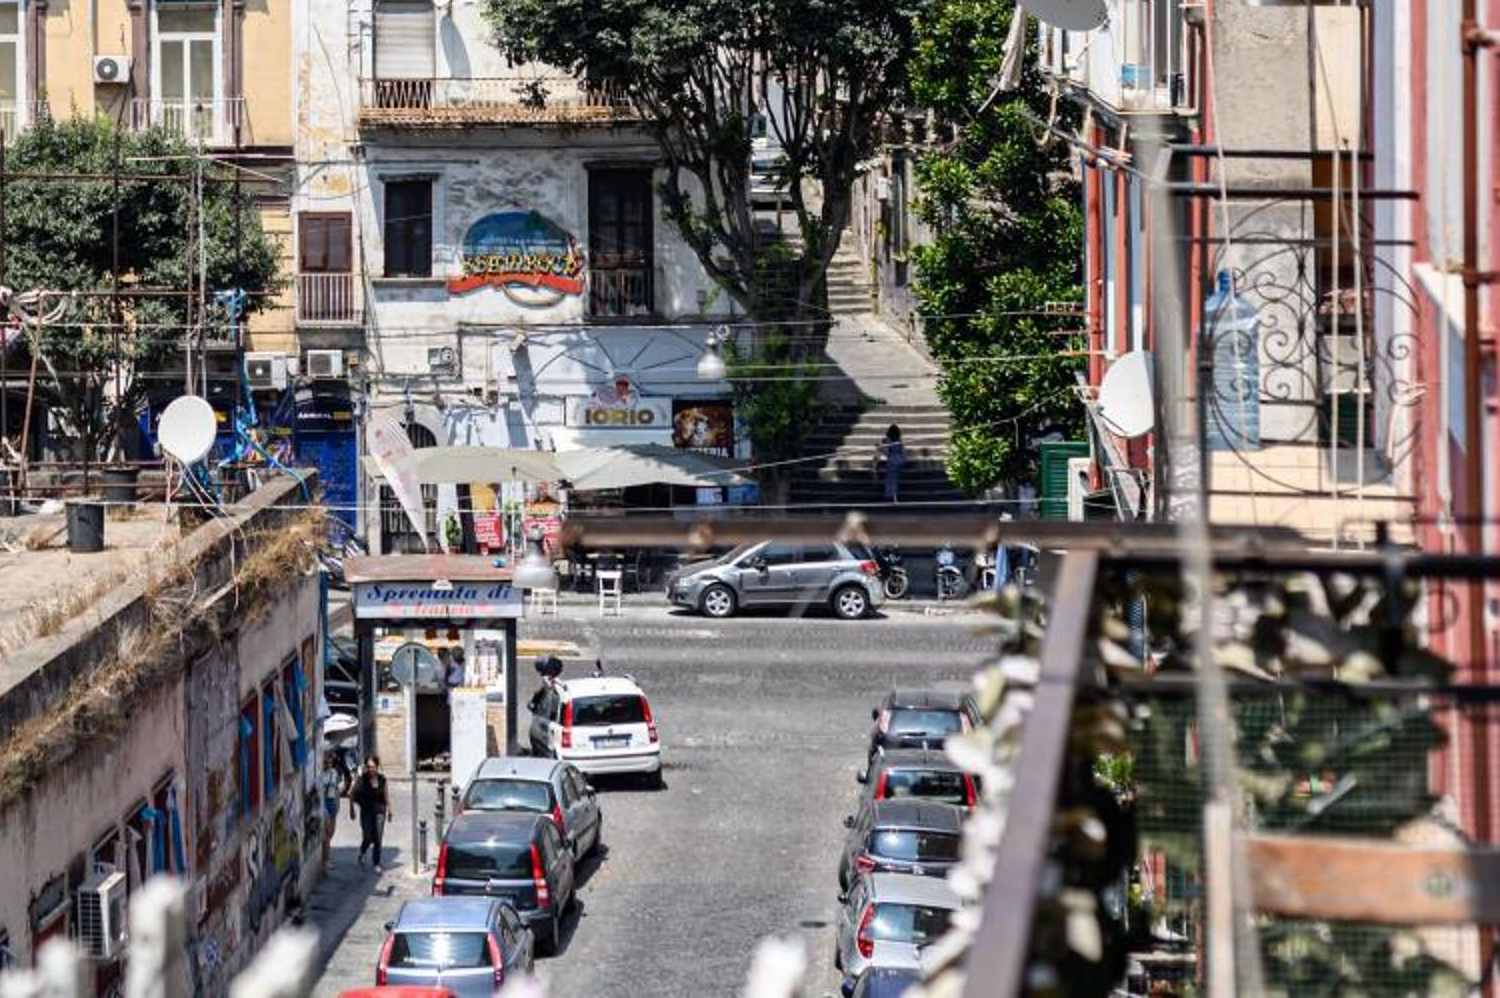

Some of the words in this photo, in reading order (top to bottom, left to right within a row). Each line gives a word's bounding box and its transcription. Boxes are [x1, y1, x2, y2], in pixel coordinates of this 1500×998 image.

[586, 408, 655, 425] IORIO
[367, 585, 477, 602] Spremuta
[487, 585, 512, 601] di
